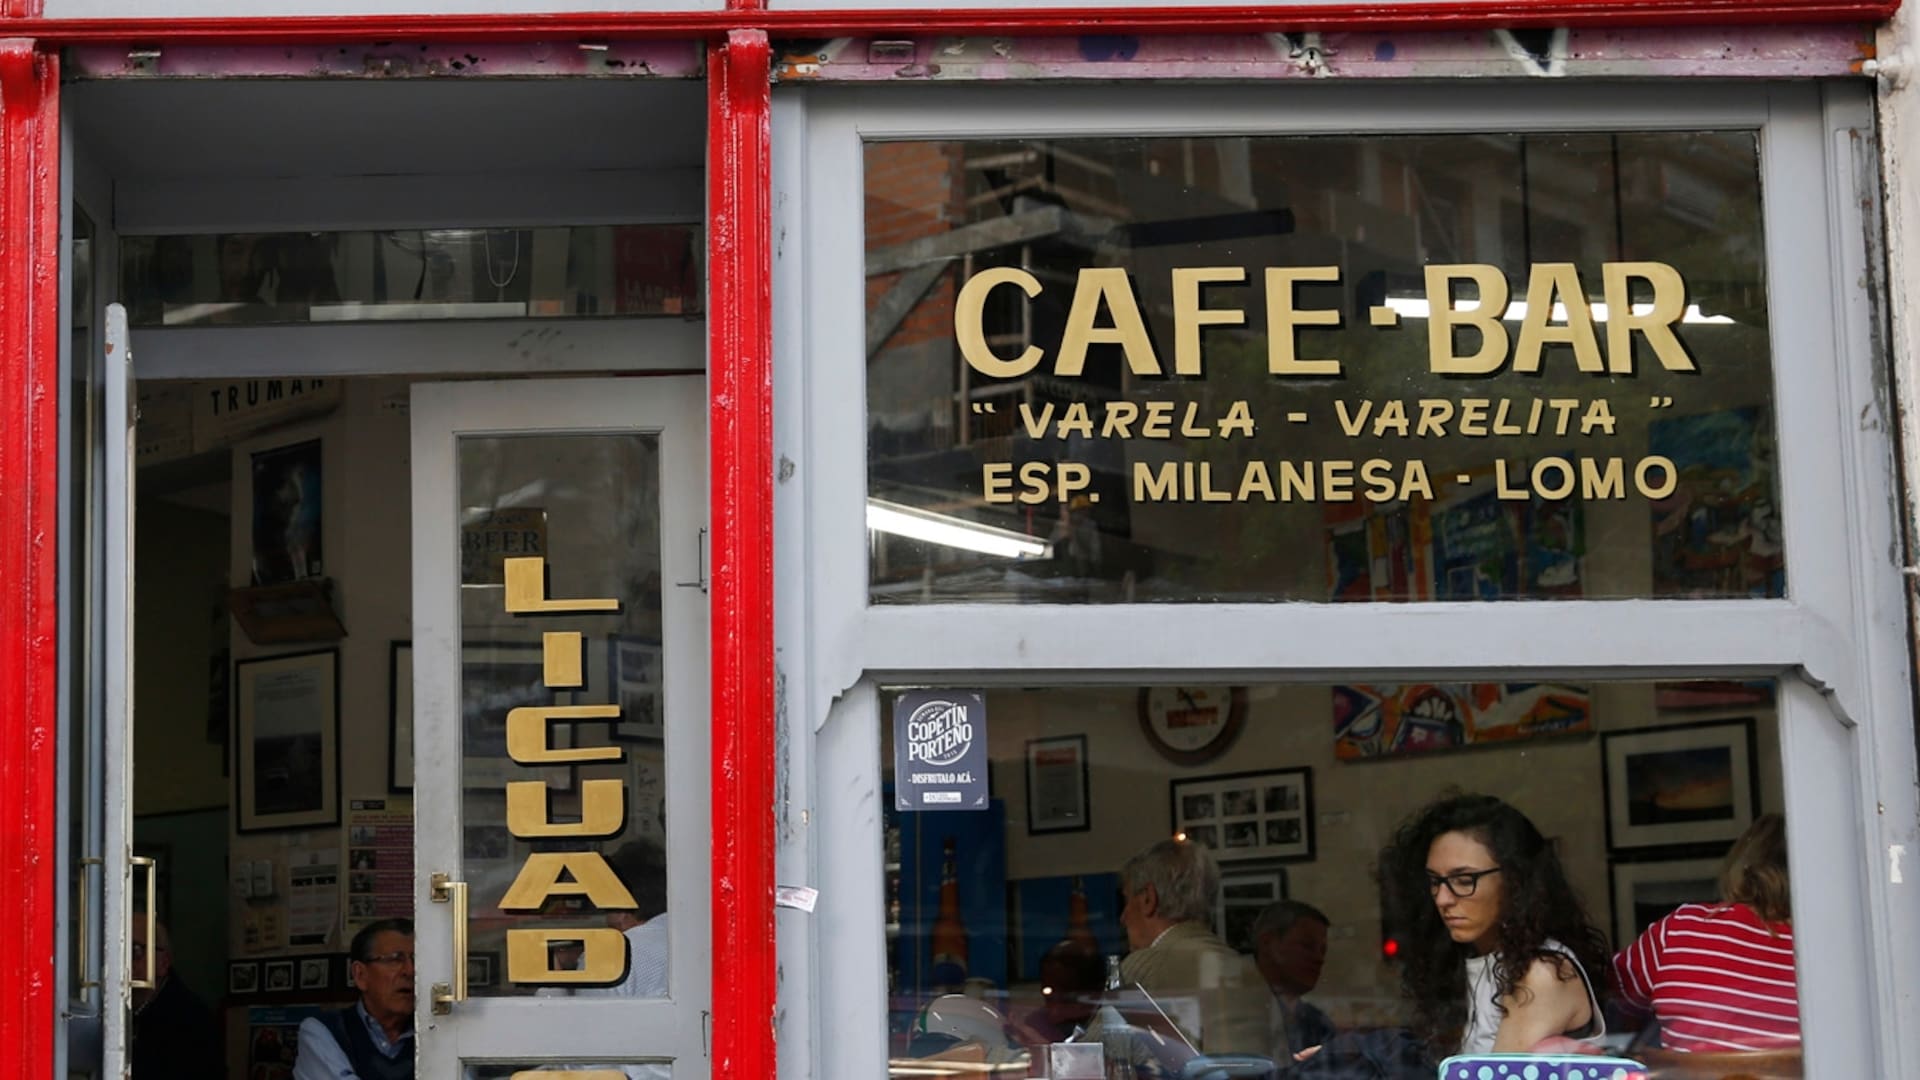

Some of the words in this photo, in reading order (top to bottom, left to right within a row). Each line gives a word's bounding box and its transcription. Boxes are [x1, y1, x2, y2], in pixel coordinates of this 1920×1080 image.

[954, 266, 1343, 377] CAFE
[1424, 262, 1695, 373] BAR
[1019, 400, 1256, 440] VARELA
[1334, 397, 1616, 437] VARELITA
[982, 462, 1100, 505] ESP.
[1133, 460, 1434, 502] MILANESA
[1495, 455, 1678, 501] LOMO
[463, 530, 541, 553] BEER
[908, 703, 967, 741] COPETÍN
[498, 556, 639, 1080] LICUAD
